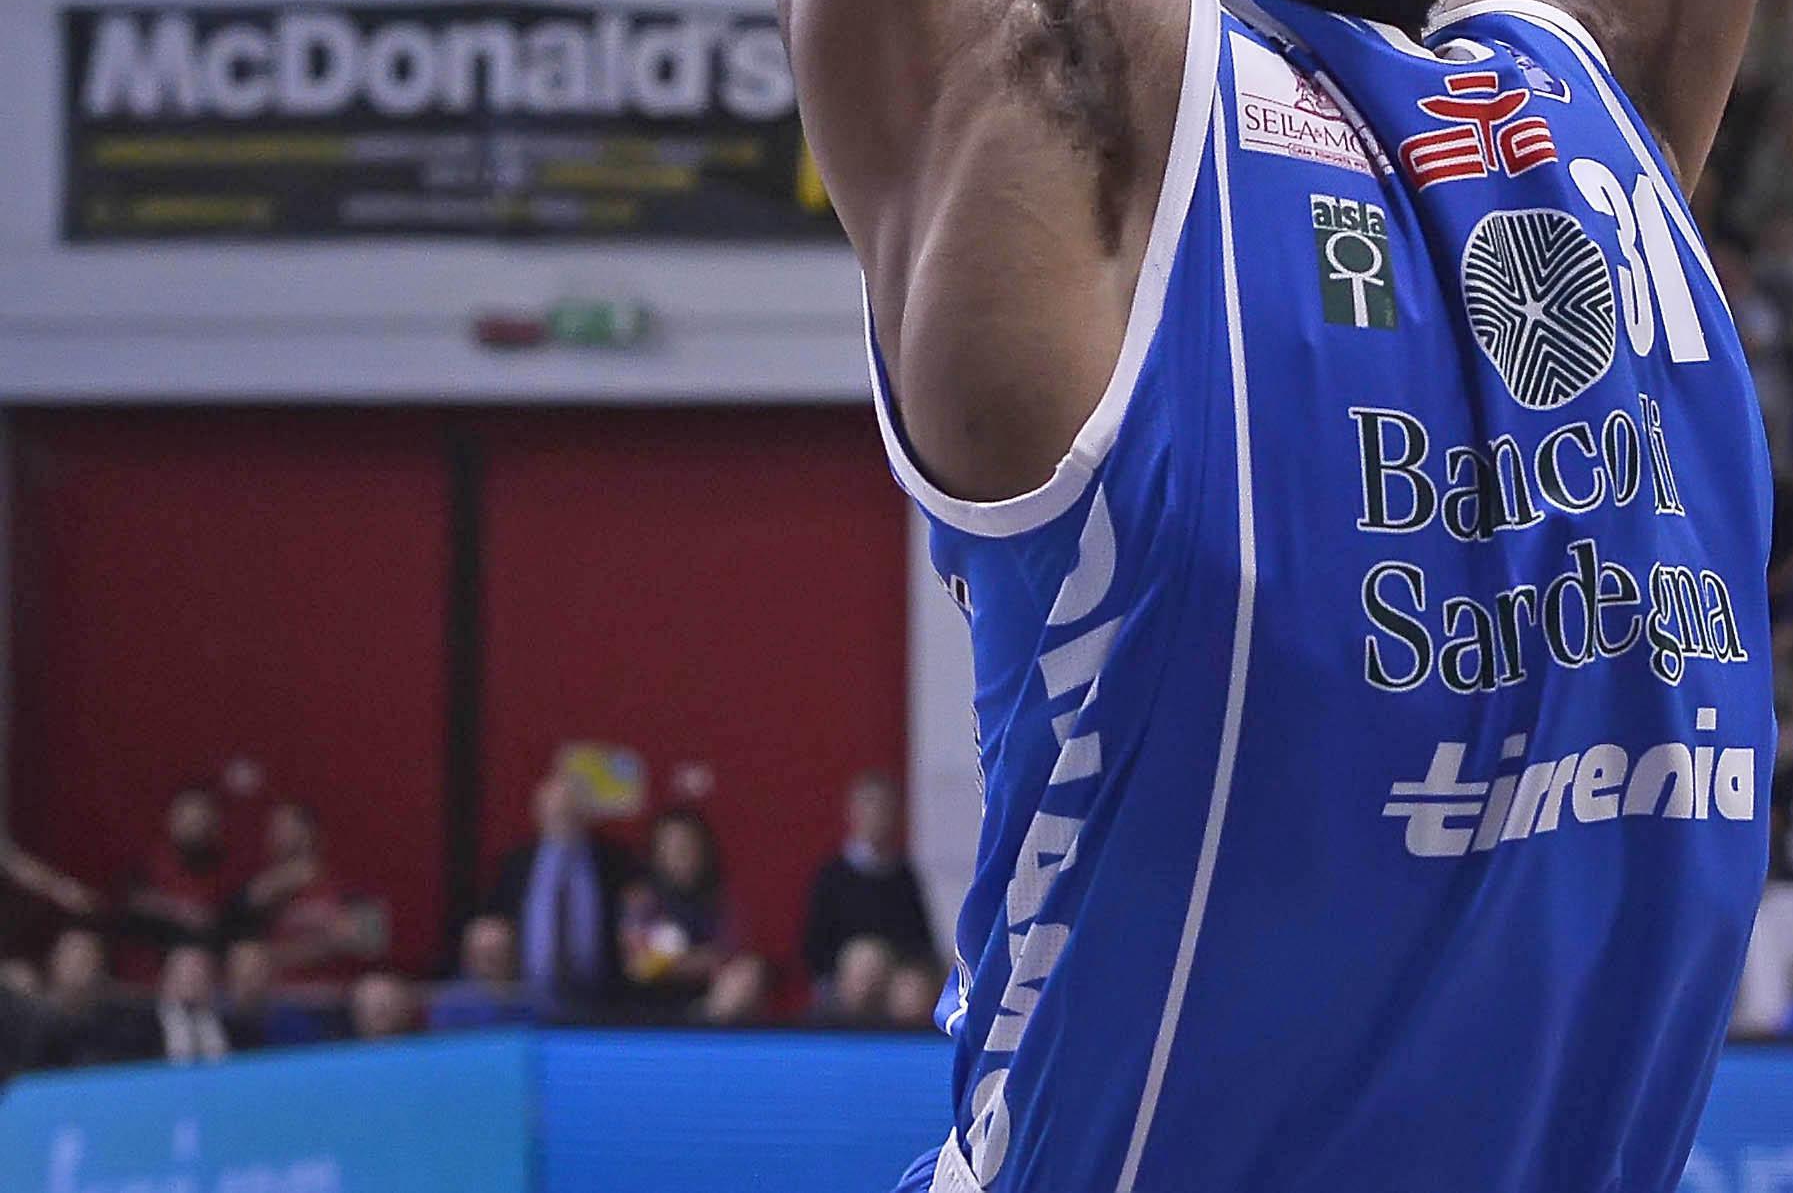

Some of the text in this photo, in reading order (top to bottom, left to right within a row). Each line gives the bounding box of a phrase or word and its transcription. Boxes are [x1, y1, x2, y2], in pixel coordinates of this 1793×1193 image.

[83, 10, 797, 120] McDonald's
[1568, 158, 1710, 363] 31
[1349, 406, 1641, 542] Banco
[1361, 538, 1748, 687] Sardegna
[1382, 707, 1755, 857] tirrenia
